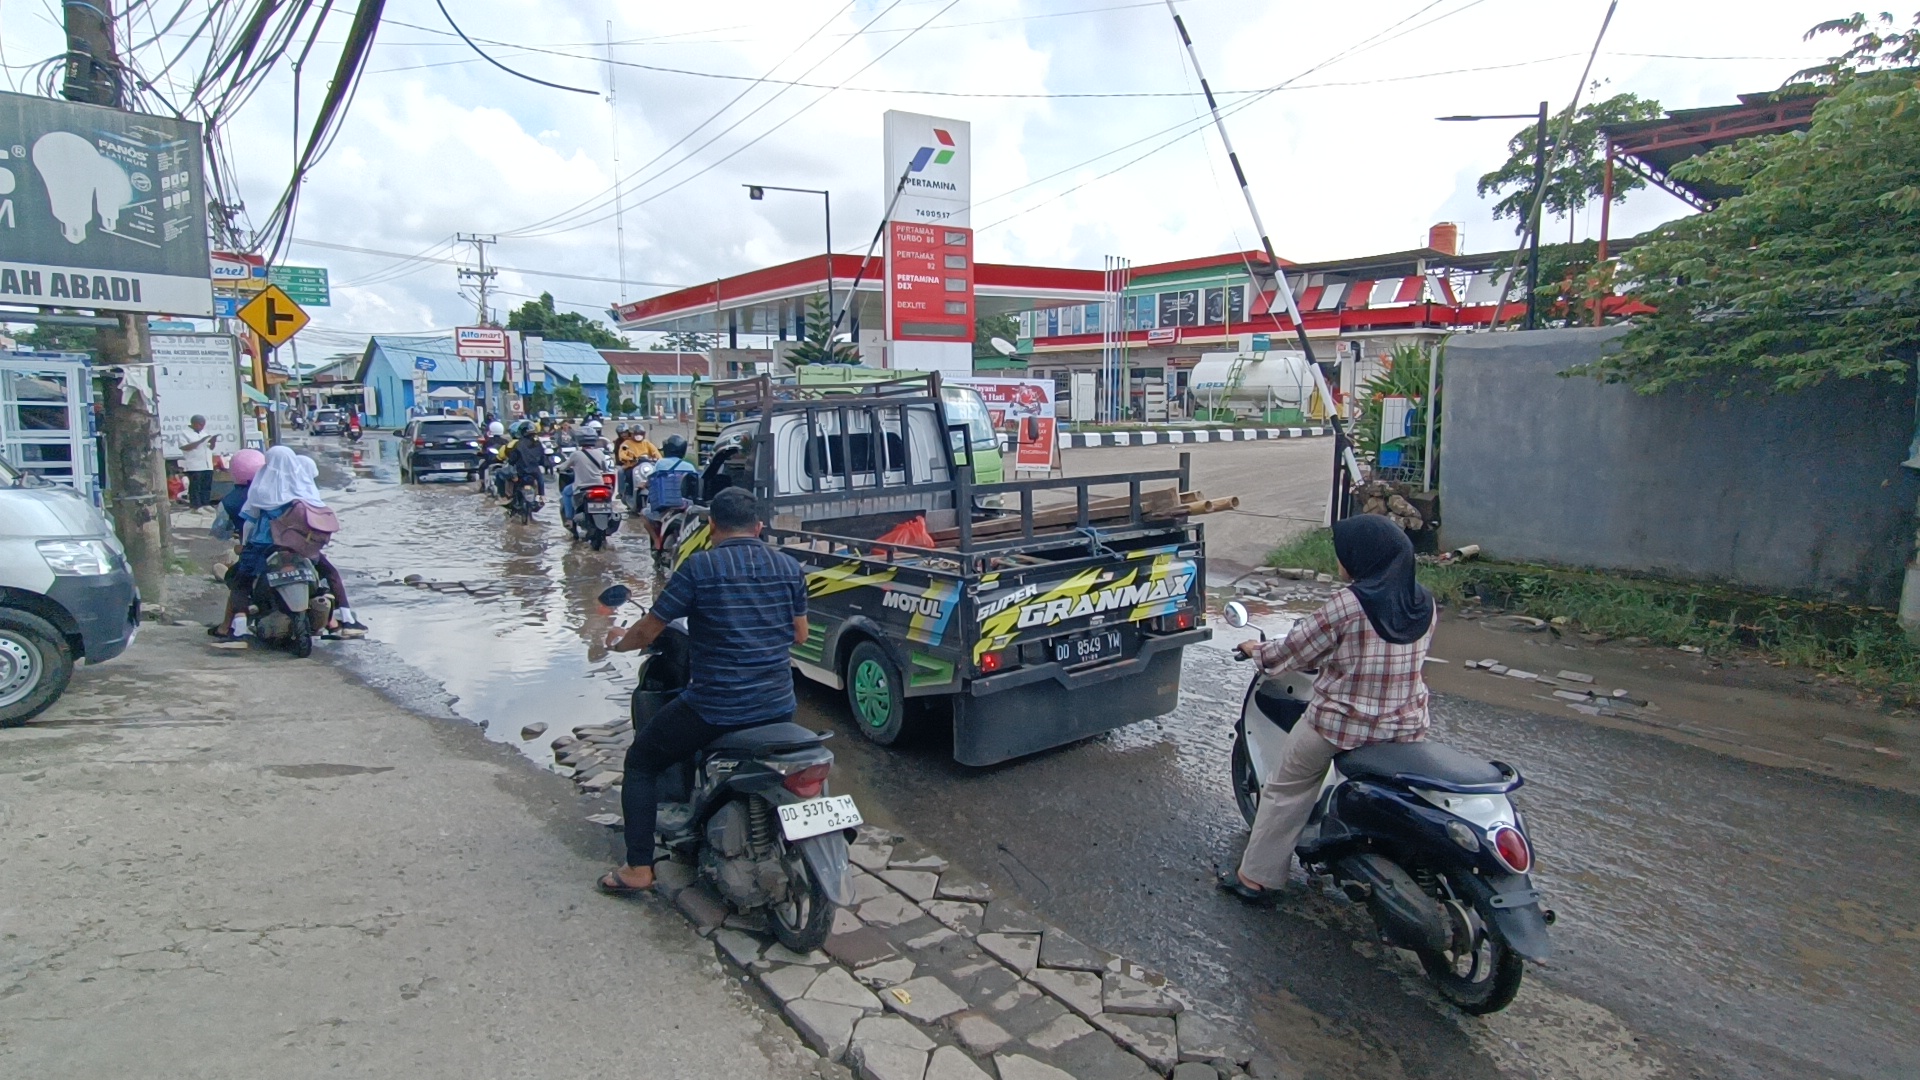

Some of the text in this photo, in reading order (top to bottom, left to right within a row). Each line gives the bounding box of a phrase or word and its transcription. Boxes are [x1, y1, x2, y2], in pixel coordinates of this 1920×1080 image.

[906, 177, 957, 191] PERTAMINA
[896, 225, 935, 236] PERTAMAX
[897, 233, 923, 243] TURBO
[896, 250, 935, 261] PERTAMAX
[897, 273, 940, 285] PERTAMINA
[50, 273, 142, 303] ABADI
[897, 282, 913, 290] DEX
[897, 301, 927, 309] DEXLITE
[460, 331, 502, 339] Alfamart
[988, 393, 1006, 401] Hati
[882, 591, 942, 618] MOTUL
[976, 583, 1038, 622] SUPER
[1017, 573, 1193, 628] GRANMAX
[1057, 643, 1070, 661] DD
[1077, 638, 1101, 655] 8549
[1107, 632, 1121, 648] YW
[802, 800, 833, 818] 5376
[837, 797, 854, 811] TM
